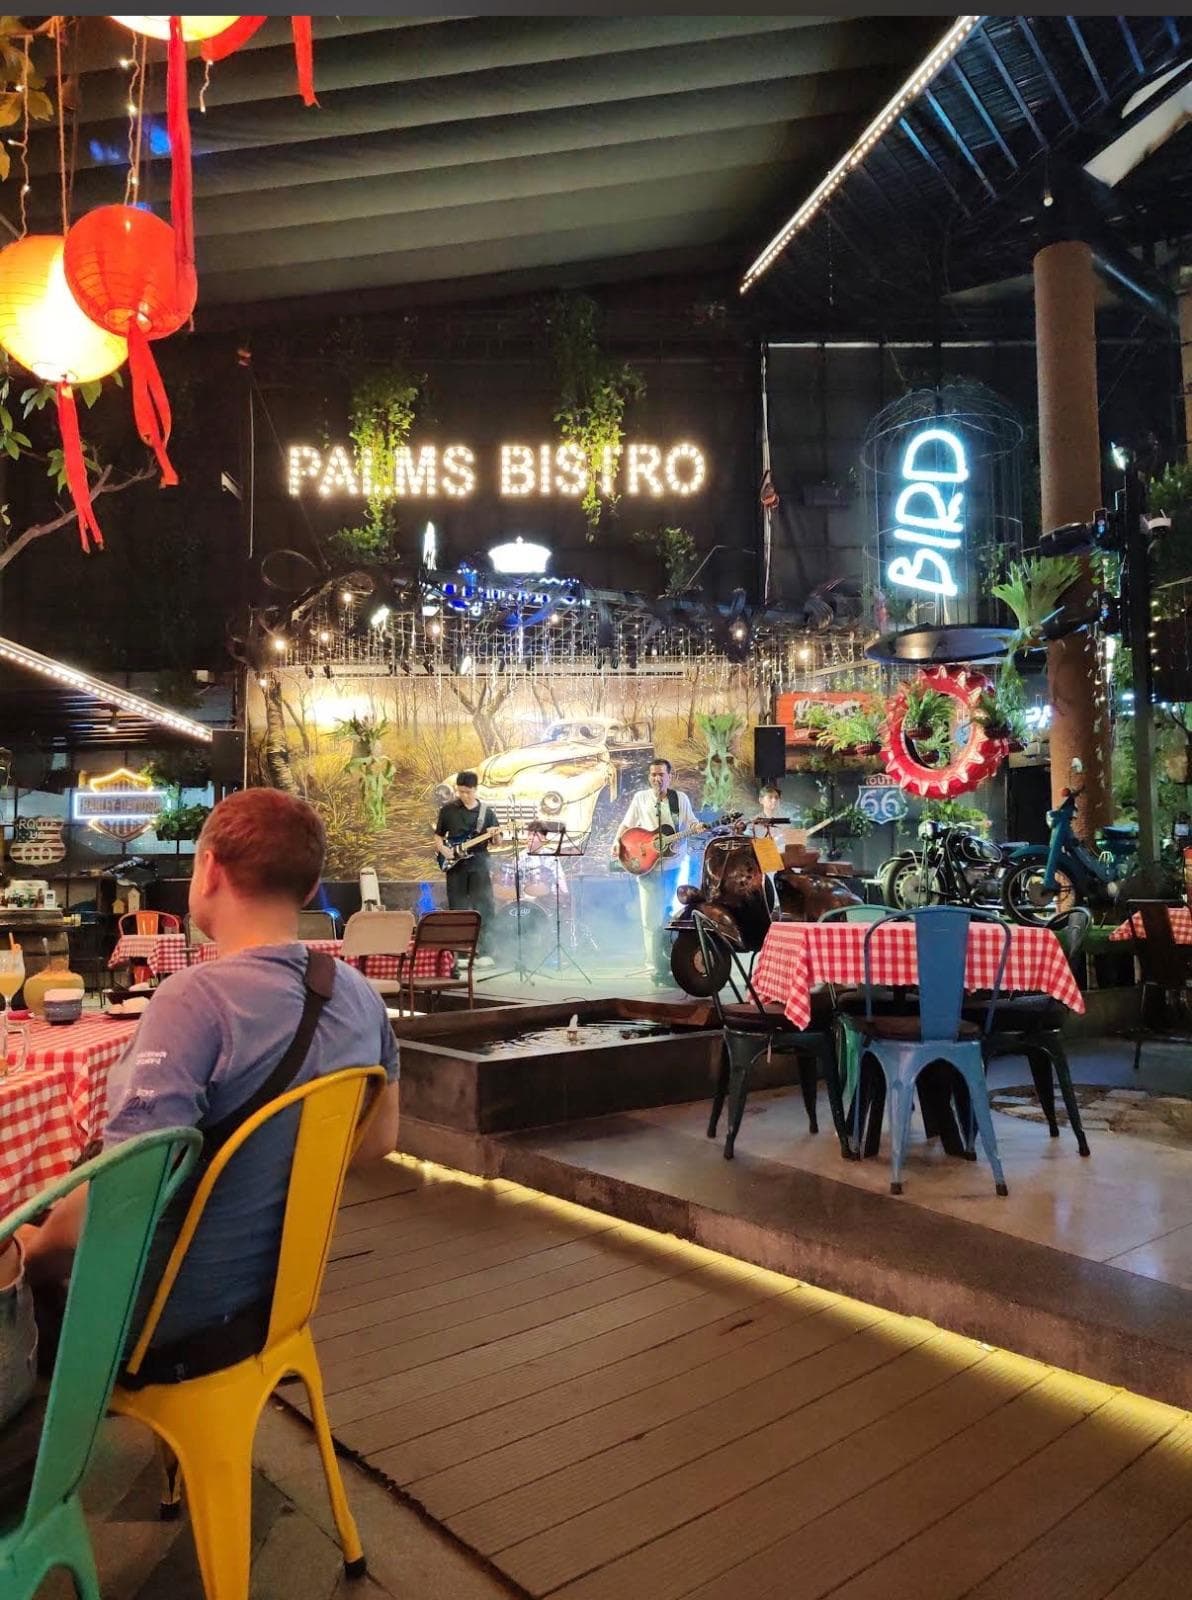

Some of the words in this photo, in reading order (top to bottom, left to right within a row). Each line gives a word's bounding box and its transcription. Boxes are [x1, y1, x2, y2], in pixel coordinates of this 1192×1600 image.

[287, 443, 477, 498] PALMS
[500, 443, 707, 497] BISTRO
[887, 428, 969, 597] BIRD
[861, 789, 901, 818] 66
